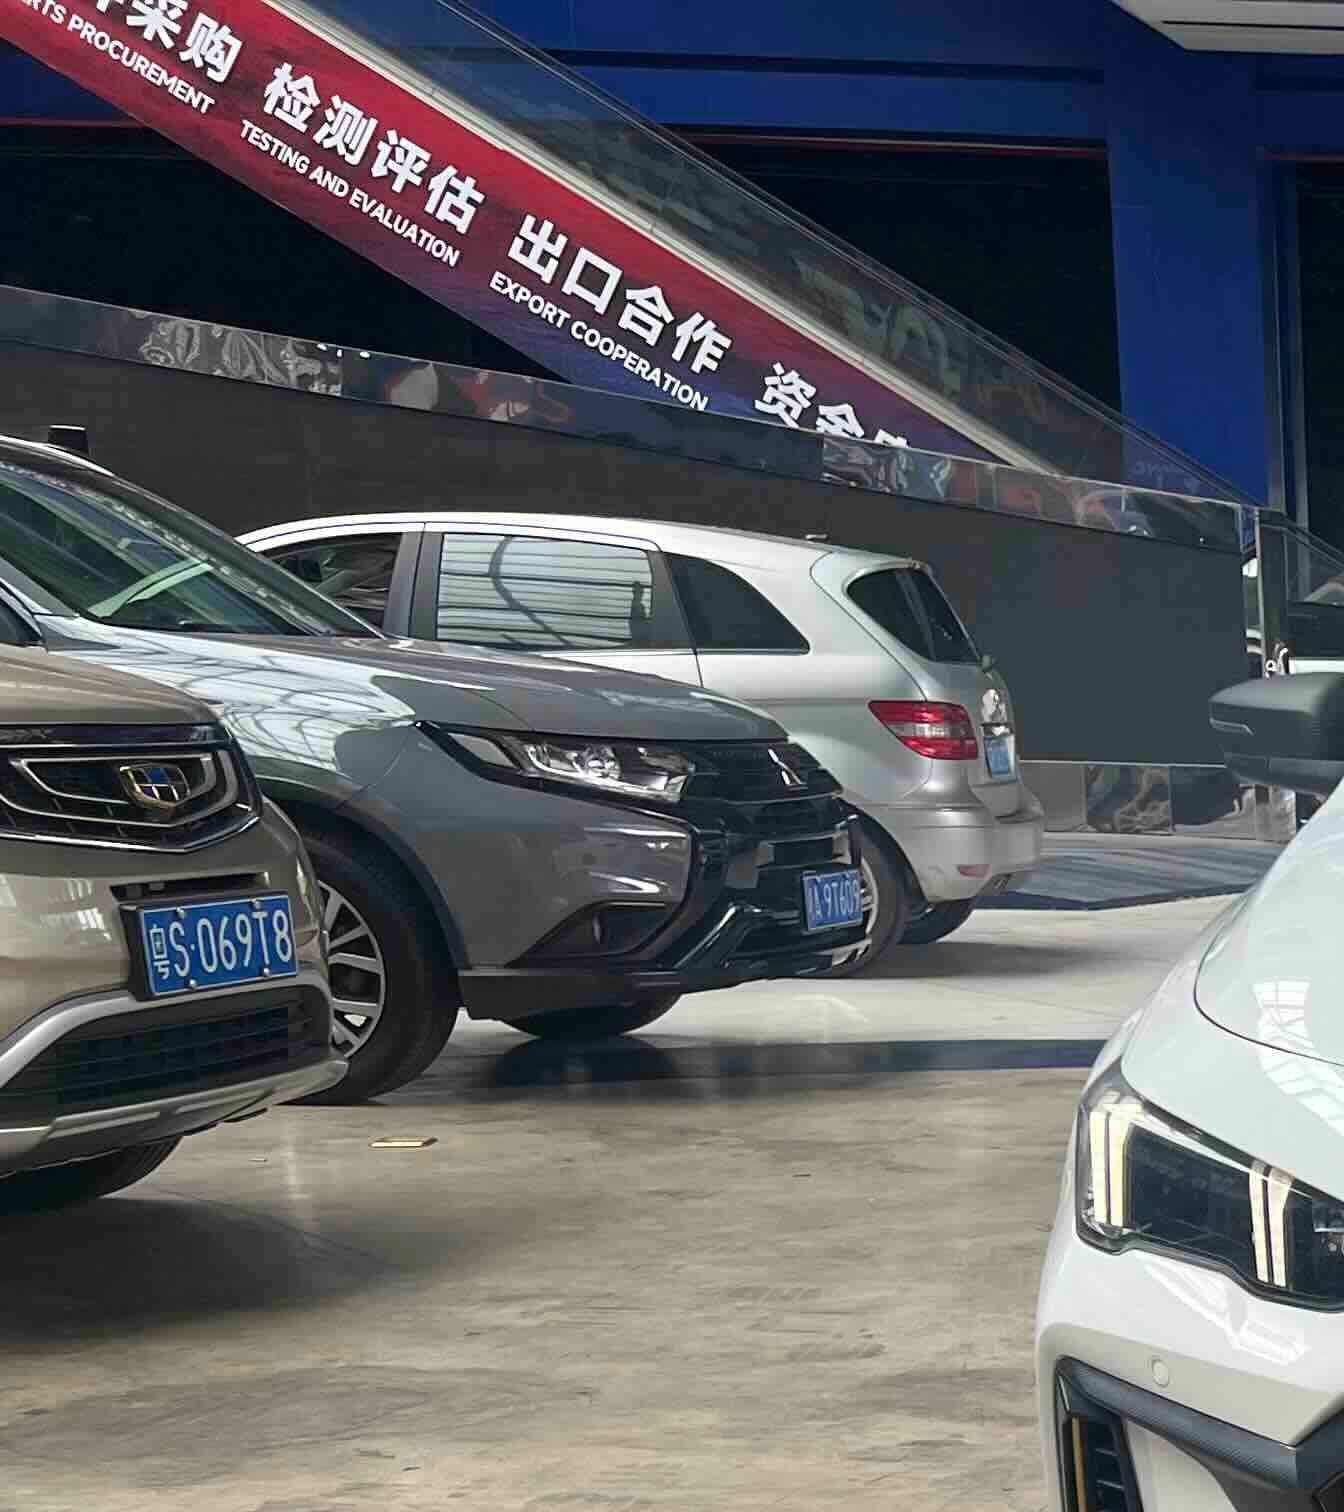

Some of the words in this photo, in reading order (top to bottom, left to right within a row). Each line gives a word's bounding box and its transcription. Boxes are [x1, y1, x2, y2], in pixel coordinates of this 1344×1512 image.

[67, 14, 215, 114] PROCUREMENT
[96, 0, 243, 83] 采购
[240, 120, 309, 174] TESTING
[309, 165, 350, 199] AND
[349, 190, 460, 267] EVALUATION
[262, 63, 485, 235] 检测评估
[489, 271, 570, 329] EXPORT
[571, 321, 709, 411] COOPERATION
[507, 215, 731, 373] 出口合作
[754, 362, 908, 448] 资金
